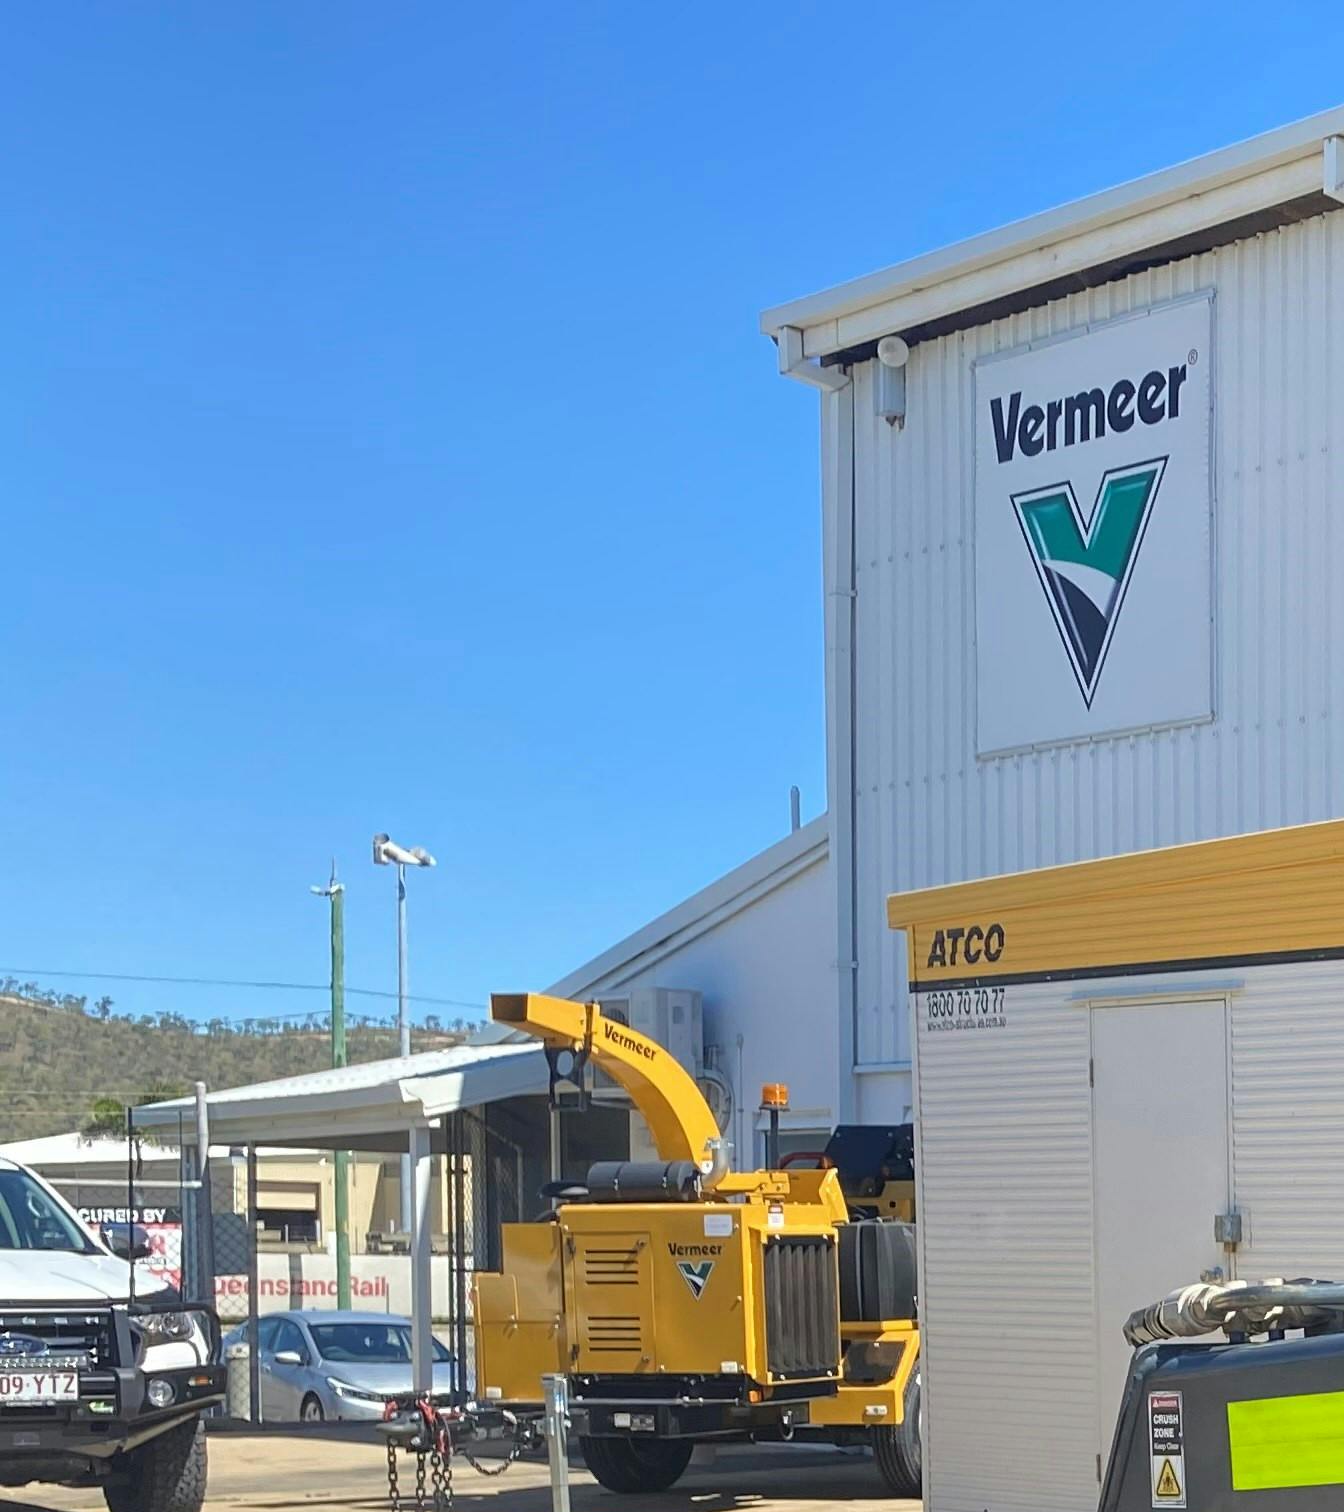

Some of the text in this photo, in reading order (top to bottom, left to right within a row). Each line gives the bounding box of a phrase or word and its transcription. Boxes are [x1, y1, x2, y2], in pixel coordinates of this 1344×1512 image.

[990, 363, 1188, 464] Vermeer
[927, 923, 1005, 968] ATCO
[927, 988, 1005, 1018] 1800 70 70 77
[604, 1022, 657, 1061] Vermeer
[143, 1208, 167, 1223] BY
[667, 1243, 723, 1256] Vermeer
[349, 1276, 387, 1296] Rail
[1153, 1414, 1179, 1425] CRUSH
[1153, 1427, 1175, 1438] ZONE
